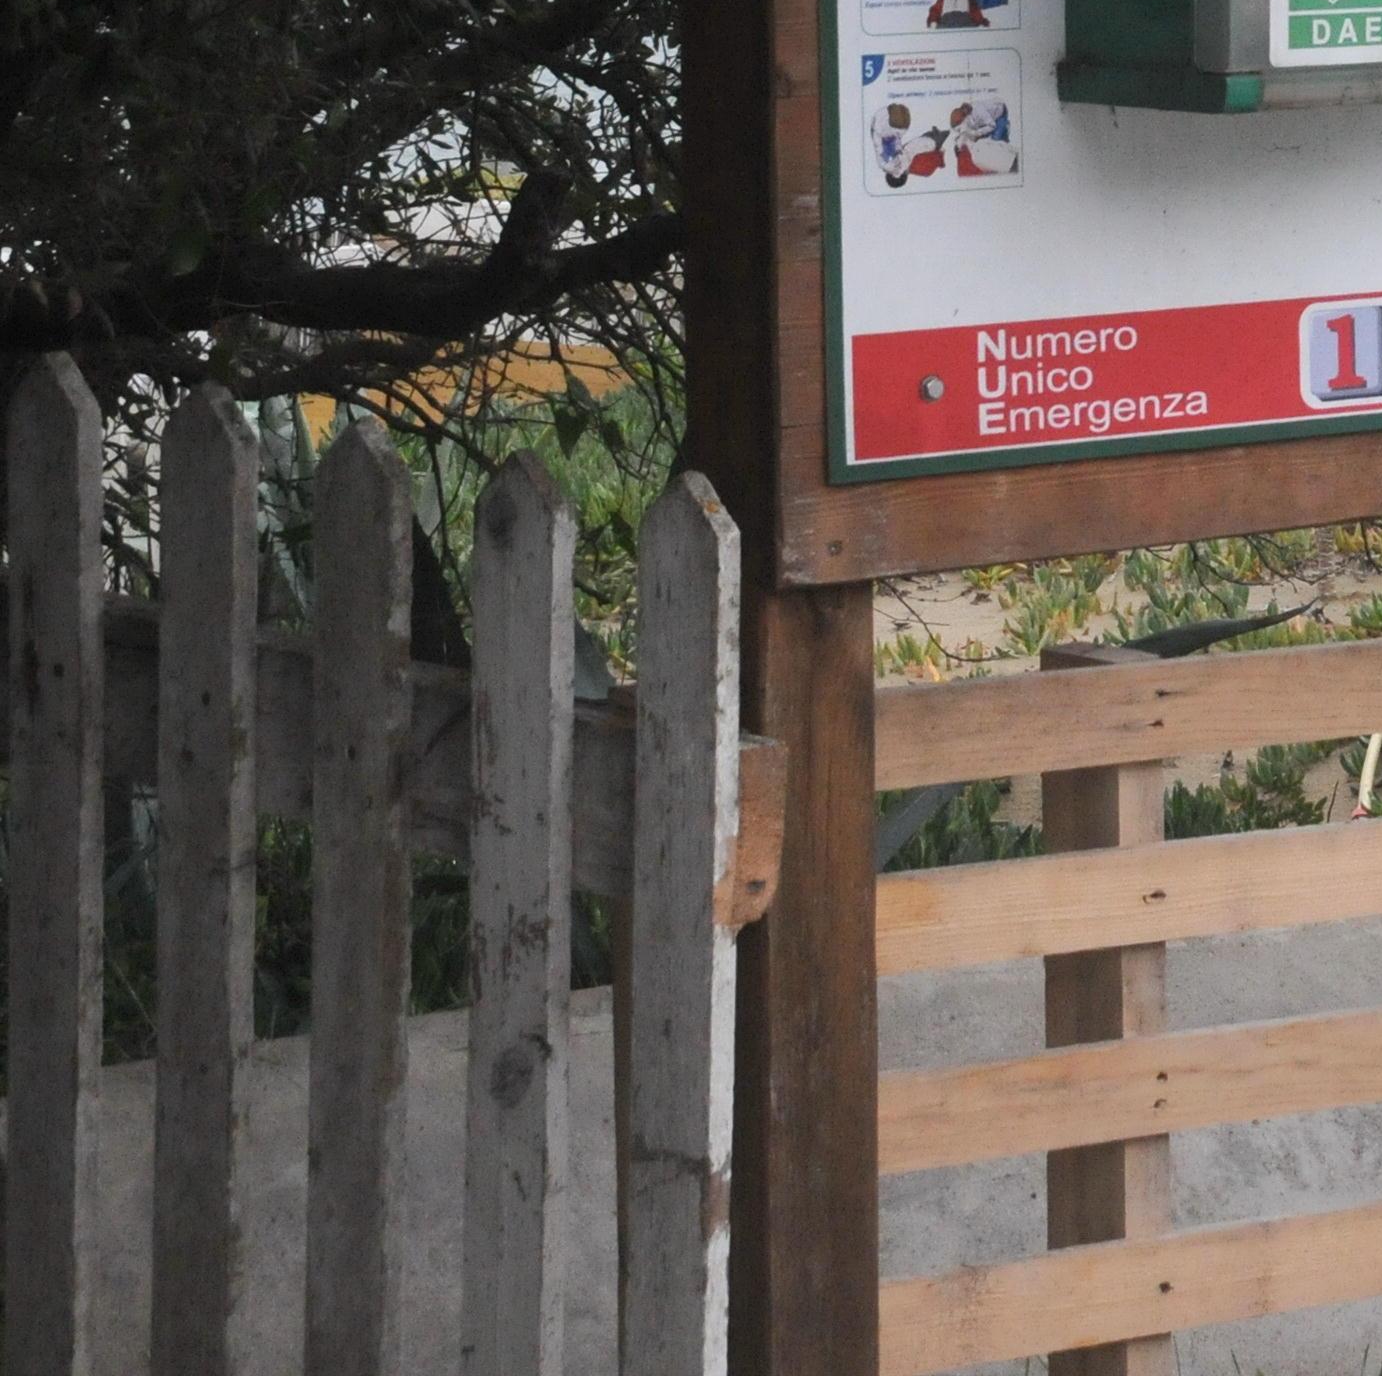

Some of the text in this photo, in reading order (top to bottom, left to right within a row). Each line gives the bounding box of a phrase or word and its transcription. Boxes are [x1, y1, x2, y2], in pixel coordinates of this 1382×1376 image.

[1312, 16, 1382, 45] DAE
[865, 60, 874, 77] 5
[977, 326, 1137, 363] Numero
[977, 362, 1094, 399] Unico
[978, 390, 1208, 436] Emergenza
